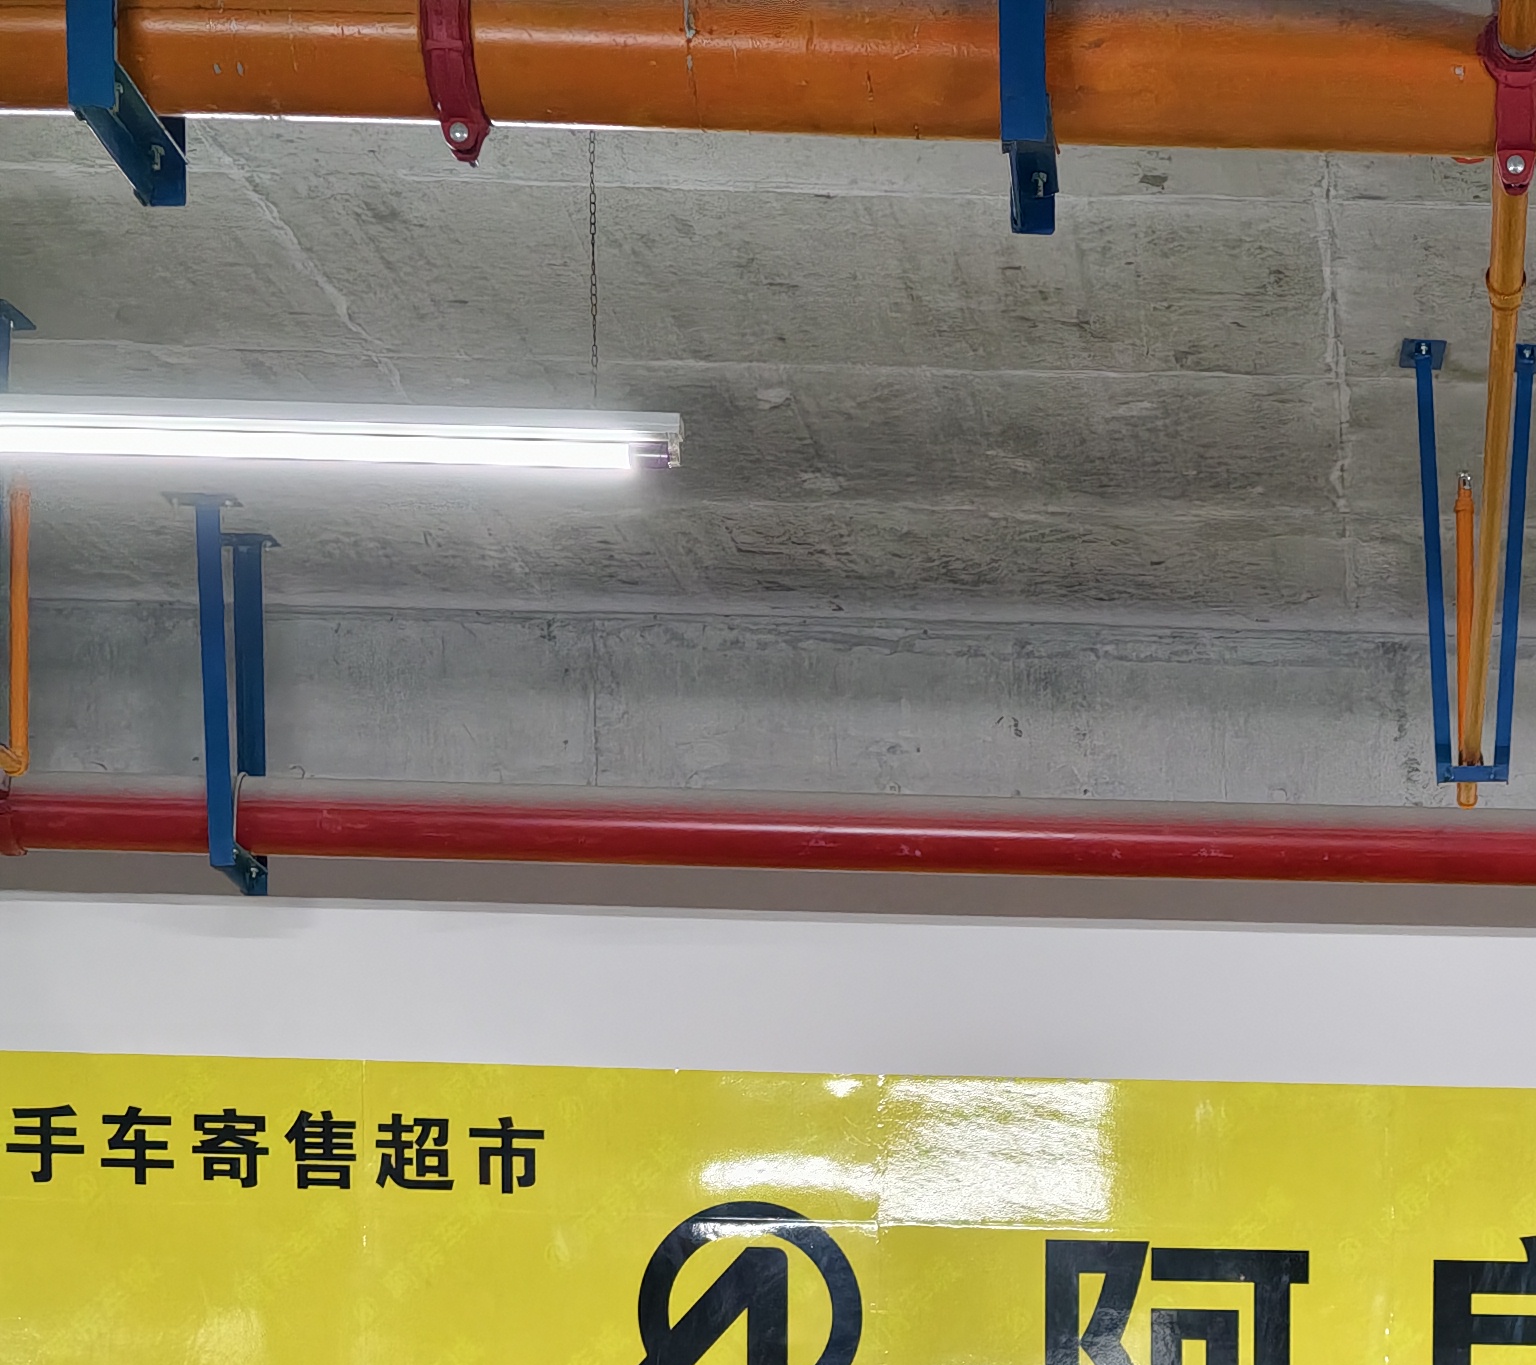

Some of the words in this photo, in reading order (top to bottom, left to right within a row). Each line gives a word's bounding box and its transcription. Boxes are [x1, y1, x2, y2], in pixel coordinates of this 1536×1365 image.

[6, 1105, 545, 1194] 手车寄售超市
